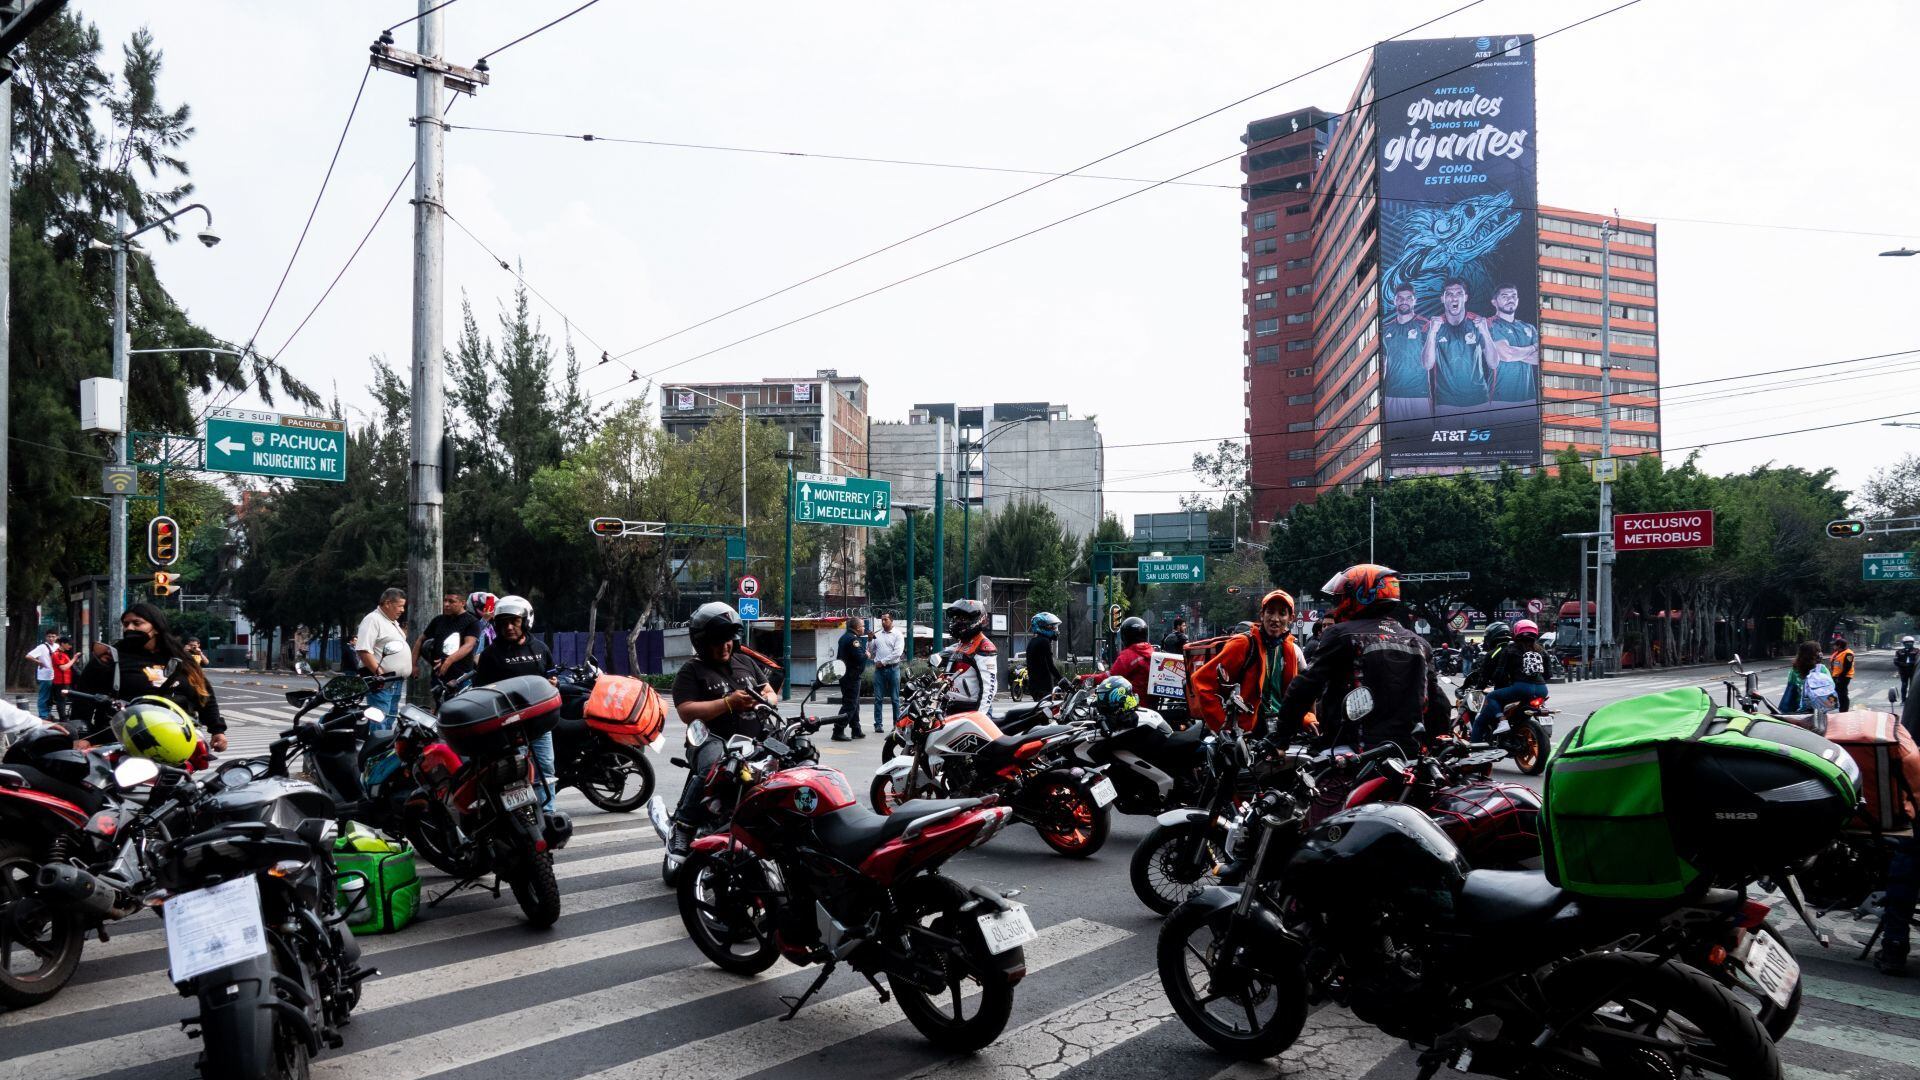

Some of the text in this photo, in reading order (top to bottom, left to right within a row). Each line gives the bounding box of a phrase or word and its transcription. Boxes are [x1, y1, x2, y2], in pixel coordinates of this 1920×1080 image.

[1434, 86, 1476, 95] ANTE LOS
[1406, 93, 1504, 126] grandes
[1430, 120, 1480, 130] SOMOS TAN
[1383, 124, 1529, 172] gigantes
[1438, 164, 1473, 174] COMO
[1424, 174, 1487, 185] ESTE MURO
[212, 409, 232, 418] EJE
[251, 413, 272, 422] SUR
[287, 418, 327, 430] PACHUCA
[1431, 429, 1491, 442] AT&T 5G
[270, 432, 338, 453] PACHUCA
[253, 451, 337, 473] INSURGENTES NTE
[804, 473, 815, 481] EJE
[814, 488, 883, 505] MONTERREY 2
[803, 505, 872, 520] 3 MEDELLIN
[1623, 516, 1702, 530] EXCLUSIVO
[1624, 531, 1702, 544] METROBUS
[1165, 563, 1189, 571] CALIFORNIA
[1714, 812, 1759, 820] SH29
